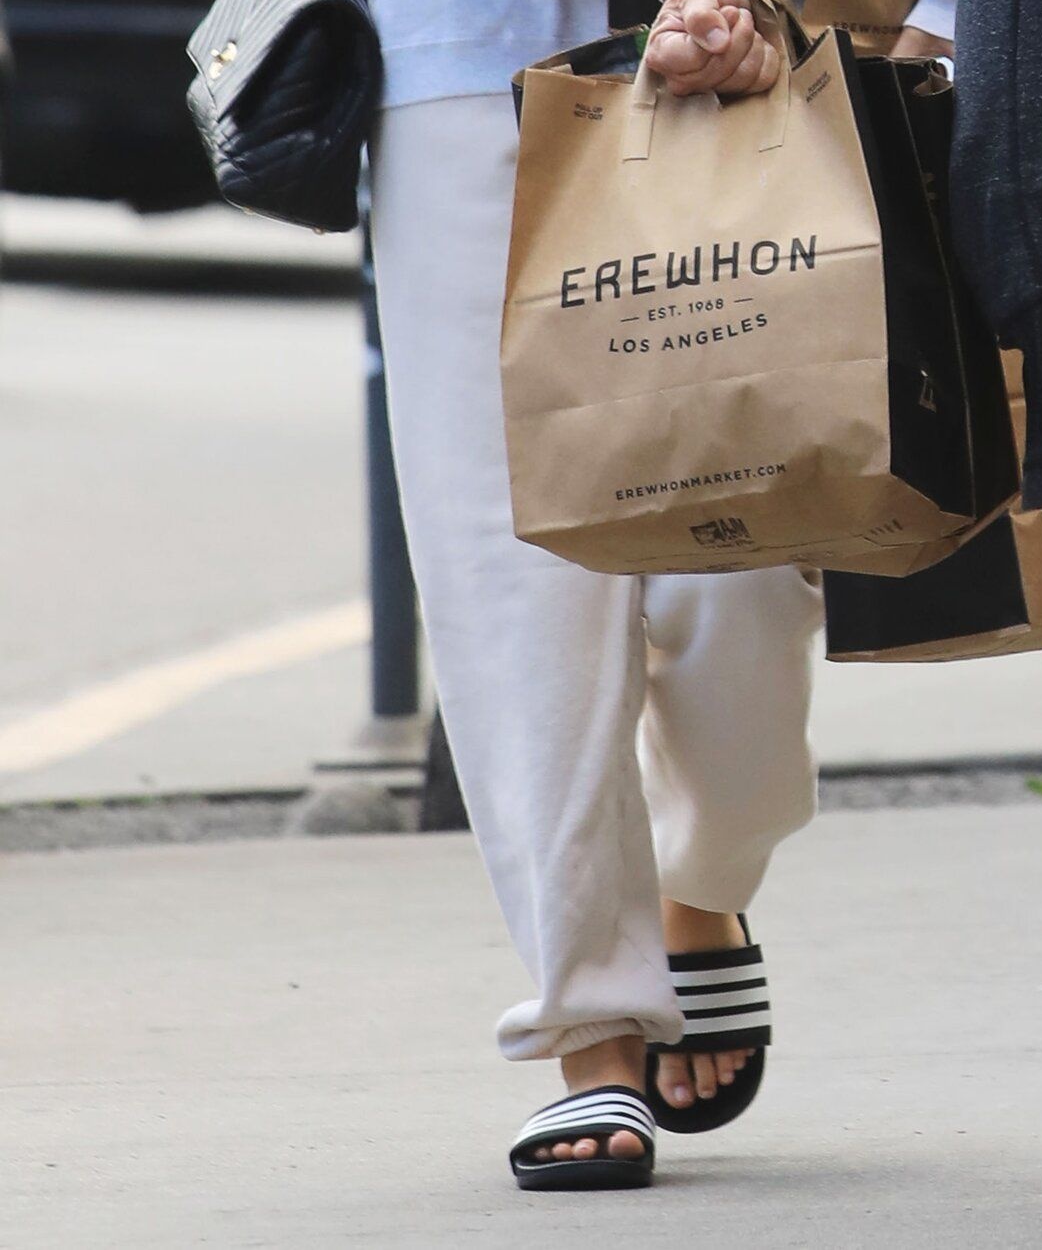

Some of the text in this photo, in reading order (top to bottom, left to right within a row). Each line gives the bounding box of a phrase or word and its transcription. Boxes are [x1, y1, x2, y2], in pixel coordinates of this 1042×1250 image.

[561, 235, 817, 308] EREWHON
[648, 298, 724, 321] EST. 1968
[609, 313, 769, 353] LOS ANGELES
[615, 463, 787, 501] EREWHONMARKET.COM
